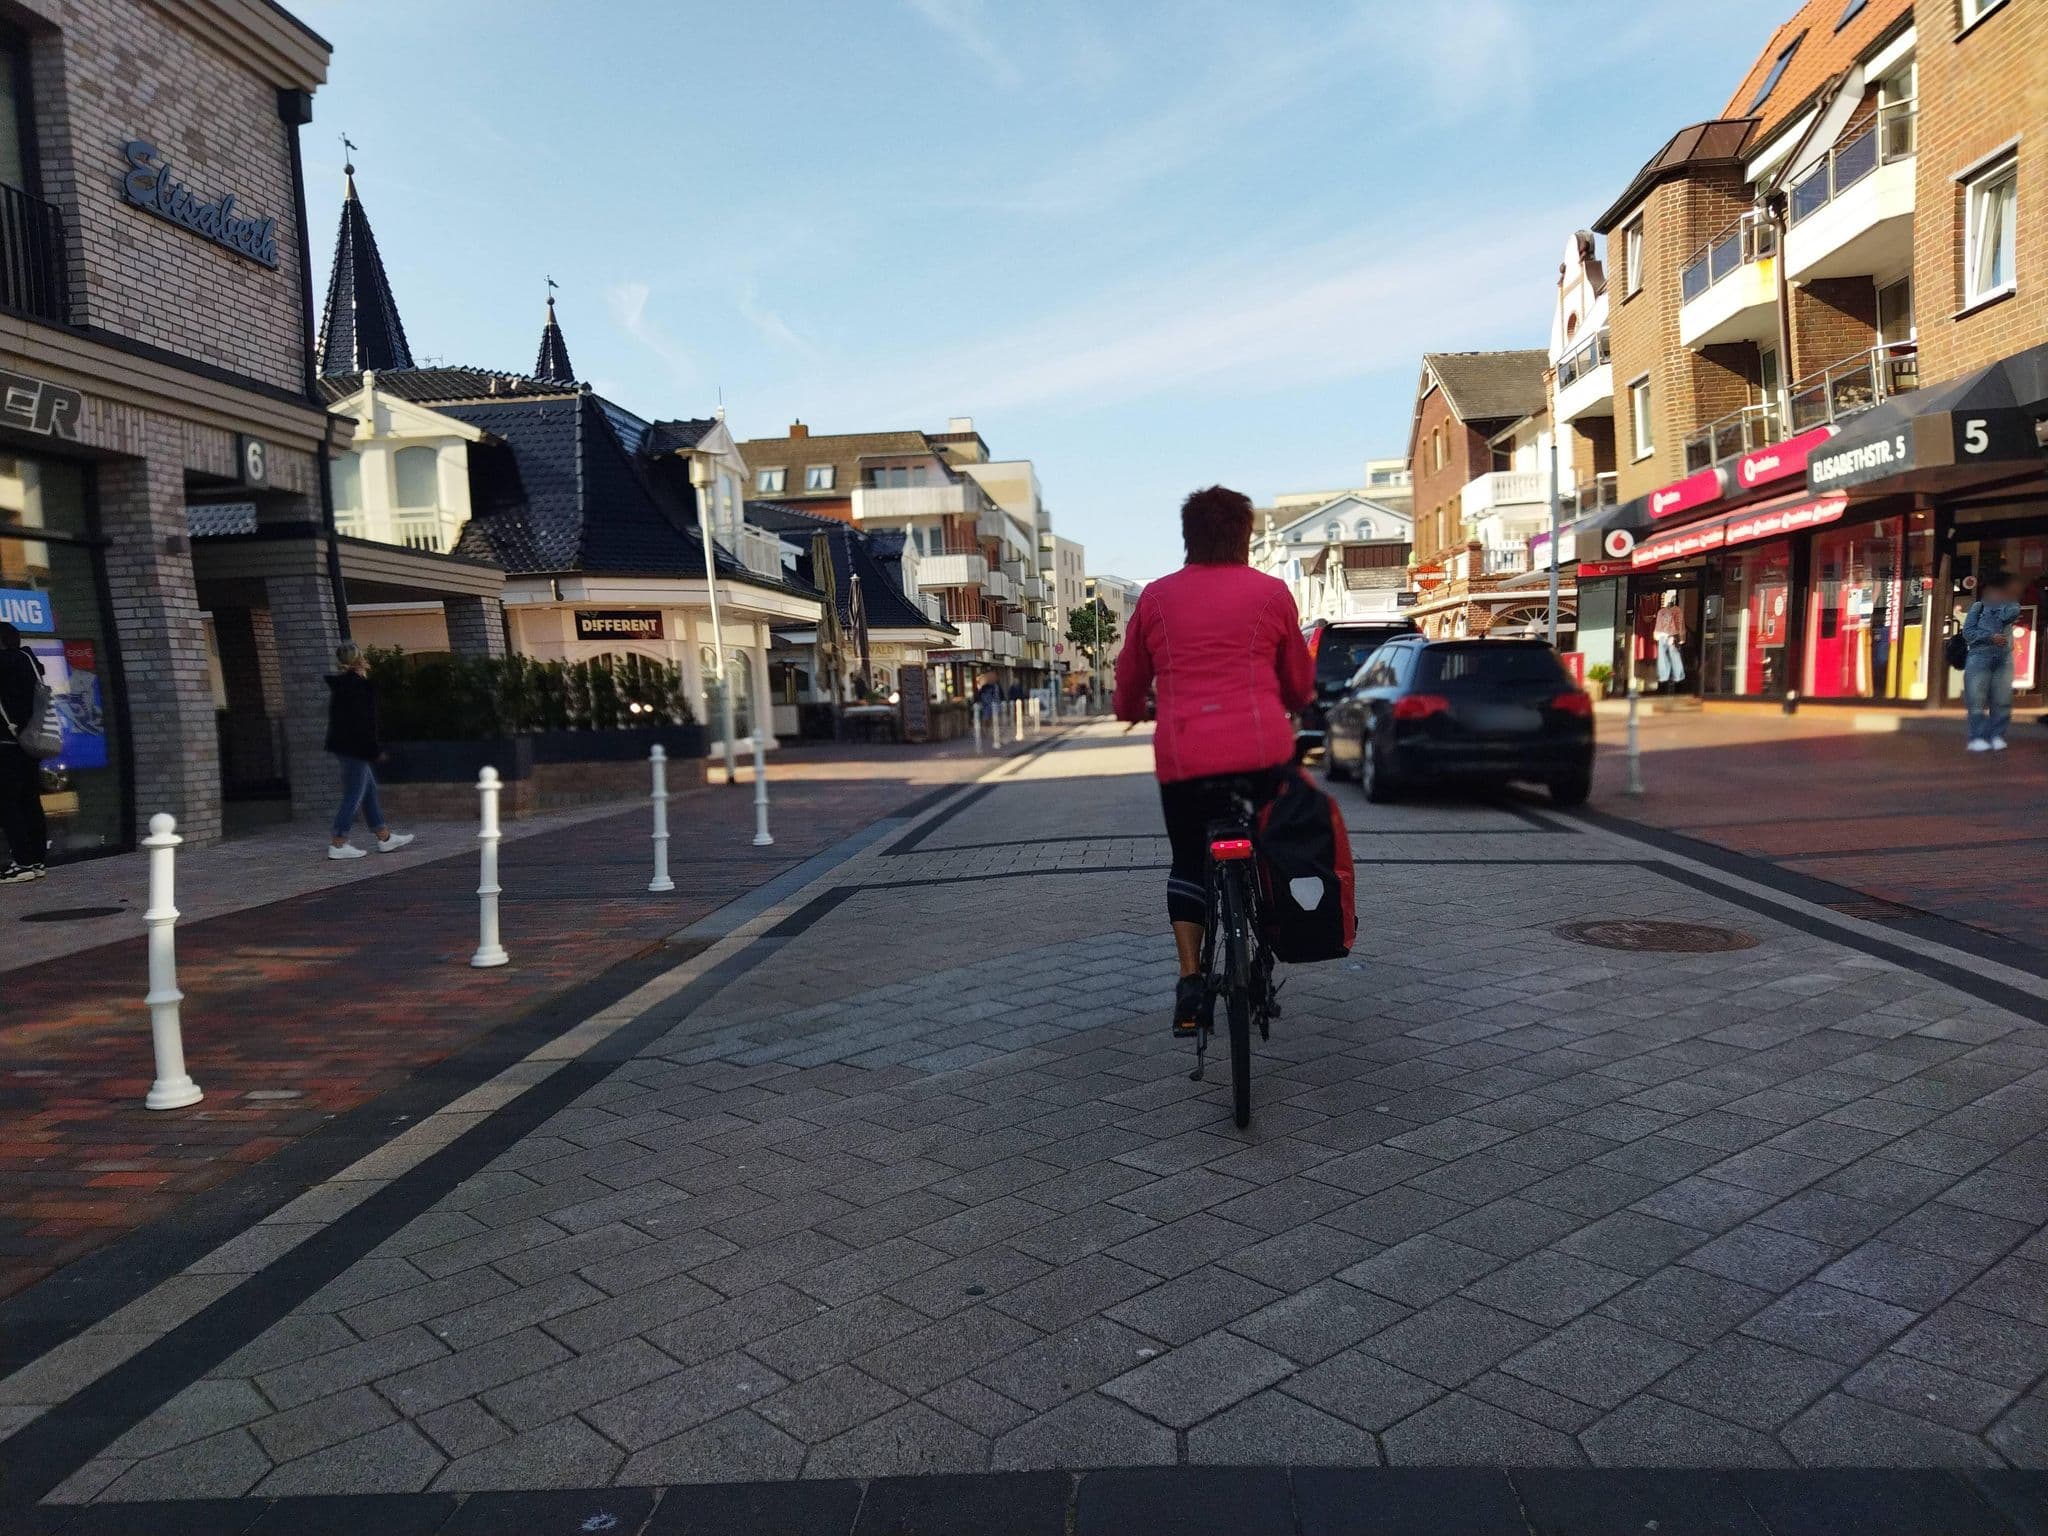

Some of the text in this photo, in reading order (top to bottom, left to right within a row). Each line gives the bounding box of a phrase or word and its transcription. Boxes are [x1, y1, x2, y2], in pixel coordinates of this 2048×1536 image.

[124, 141, 279, 268] Elisabeth
[1964, 419, 1989, 454] 5
[247, 441, 264, 481] 6
[1812, 435, 1906, 484] ELISABETHSTR. 5
